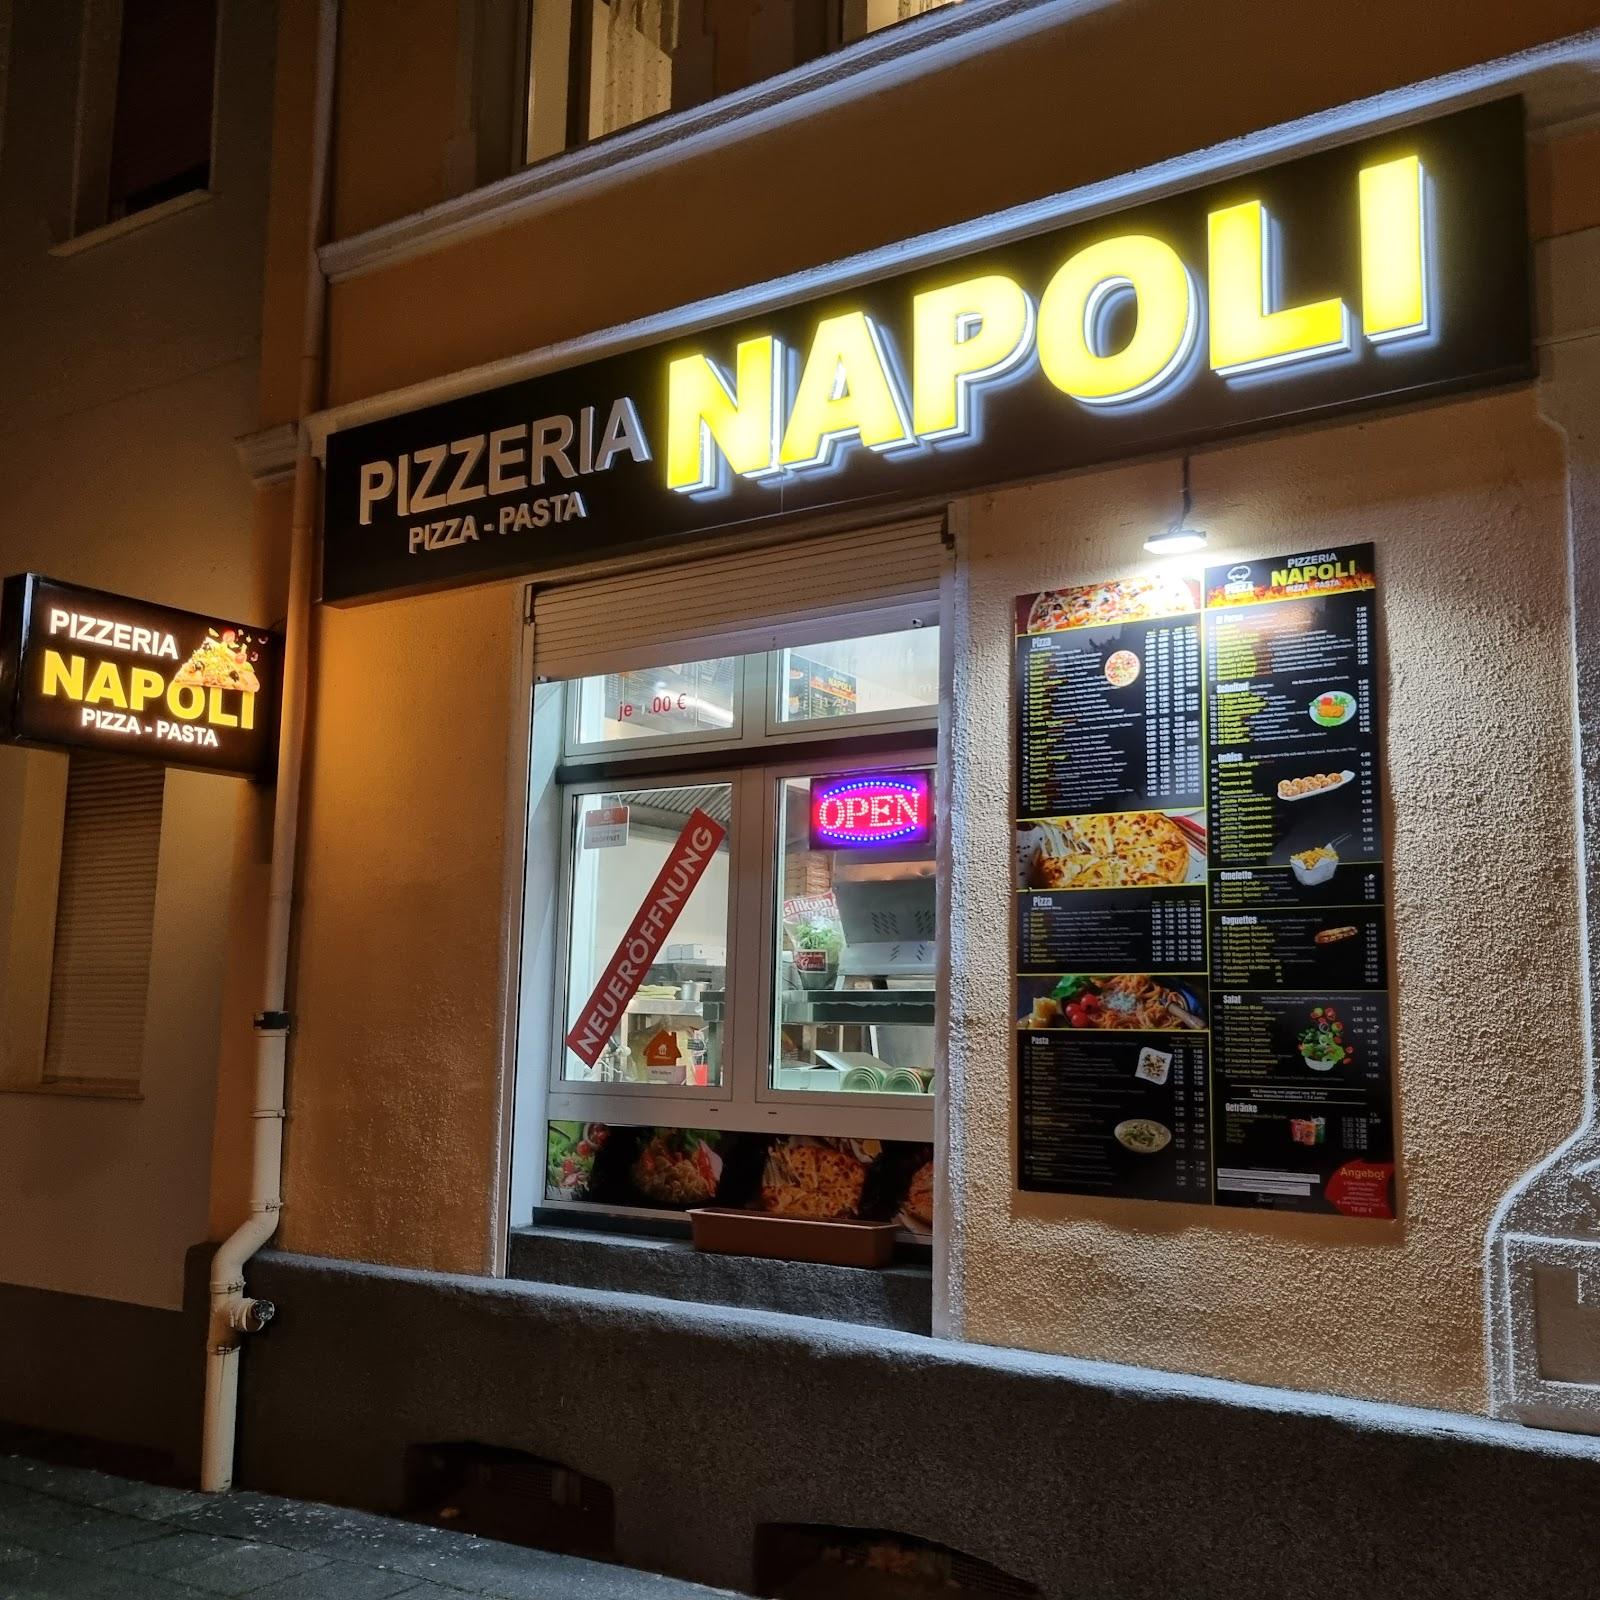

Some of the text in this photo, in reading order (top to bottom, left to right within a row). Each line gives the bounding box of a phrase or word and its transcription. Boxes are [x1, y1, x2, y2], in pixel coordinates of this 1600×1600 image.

[359, 155, 1428, 526] PIZZERIA NAPOLI
[409, 515, 479, 554] PIZZA
[498, 491, 587, 536] PASTA
[1271, 560, 1356, 587] NAPOLI
[1287, 553, 1337, 568] PIZZERIA
[1286, 584, 1308, 592] PIZZA
[1315, 579, 1339, 588] PASTA
[50, 608, 179, 660] PIZZERIA
[1032, 637, 1052, 649] Pizza
[42, 650, 255, 730] NAPOLI
[618, 693, 687, 722] je .00 €
[81, 707, 141, 735] PIZZA
[156, 720, 218, 747] PASTA
[818, 792, 919, 830] OPEN
[1033, 896, 1052, 906] Pizza
[1222, 916, 1257, 926] Baguettes
[575, 825, 714, 1056] NEUERÖFFNUNG
[1223, 995, 1241, 1004] Salat
[1226, 1103, 1258, 1113] Getränke
[1340, 1168, 1385, 1179] Angebot
